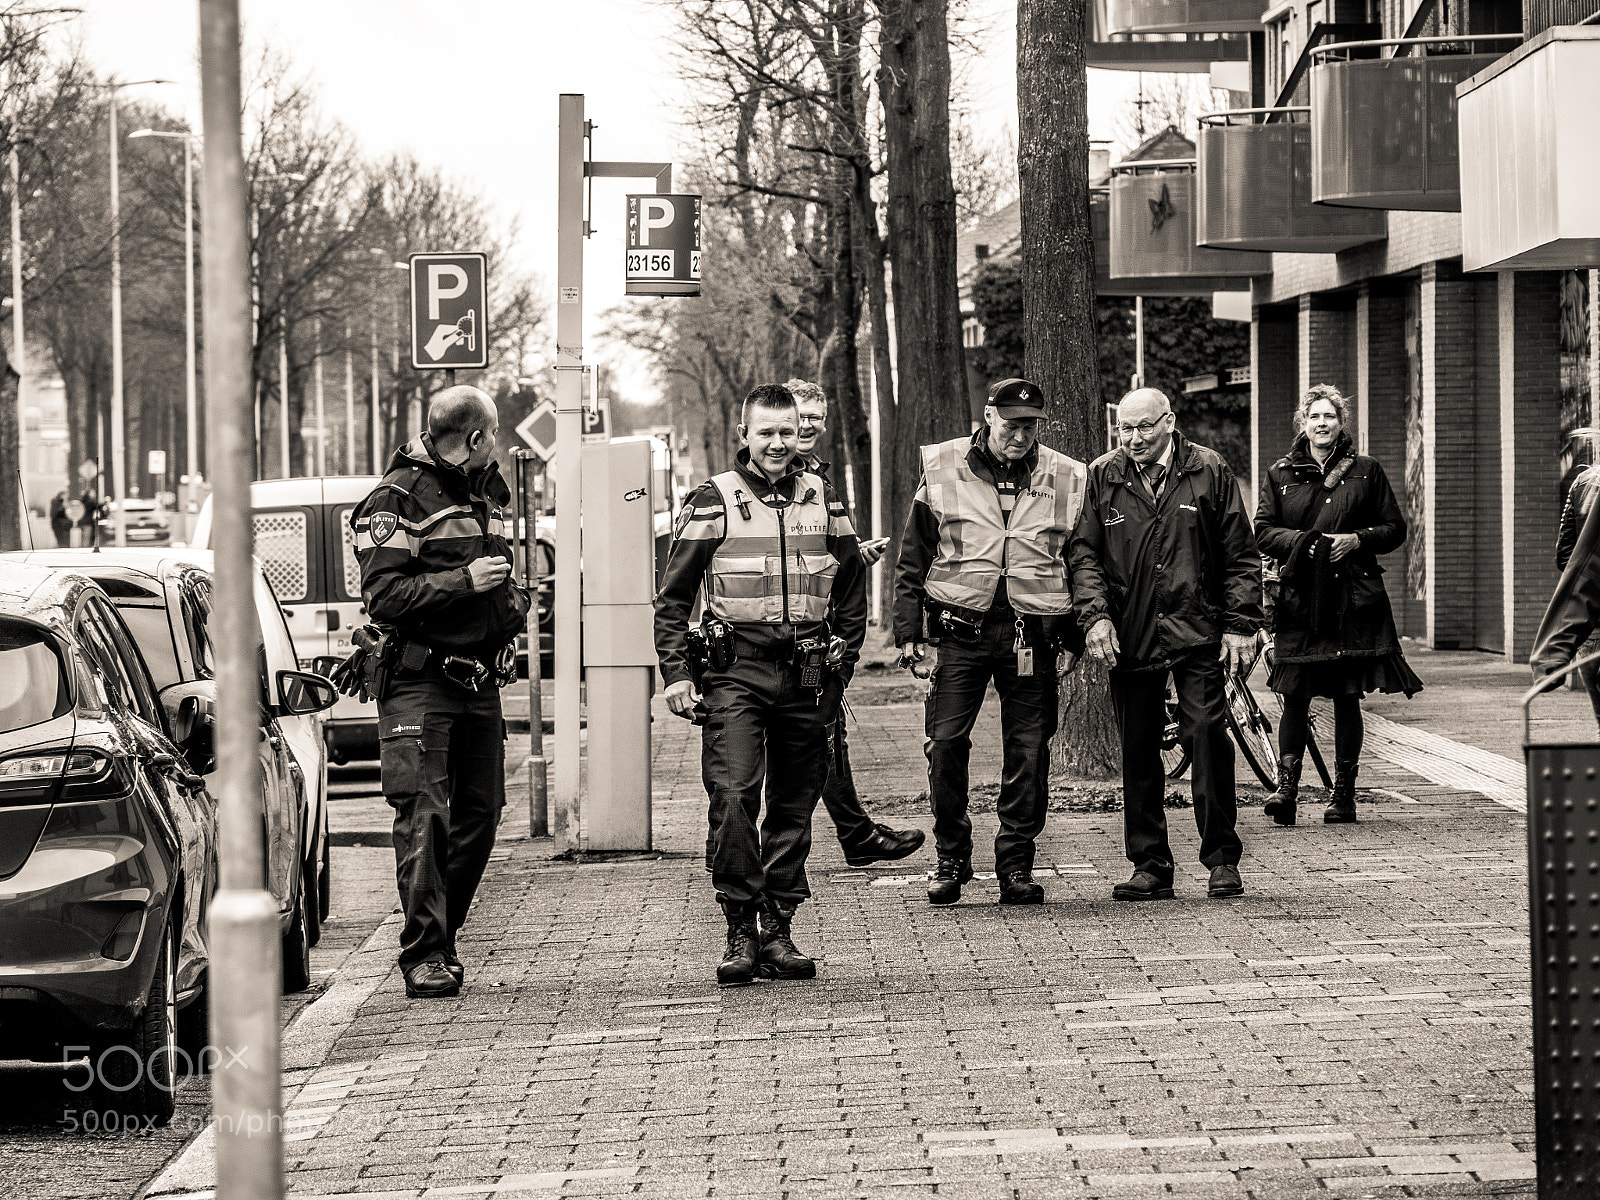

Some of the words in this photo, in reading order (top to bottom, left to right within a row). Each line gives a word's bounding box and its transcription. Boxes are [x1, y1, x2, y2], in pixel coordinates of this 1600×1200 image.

[640, 198, 675, 246] P
[628, 254, 671, 272] 23156
[428, 264, 468, 320] P
[584, 412, 600, 433] P
